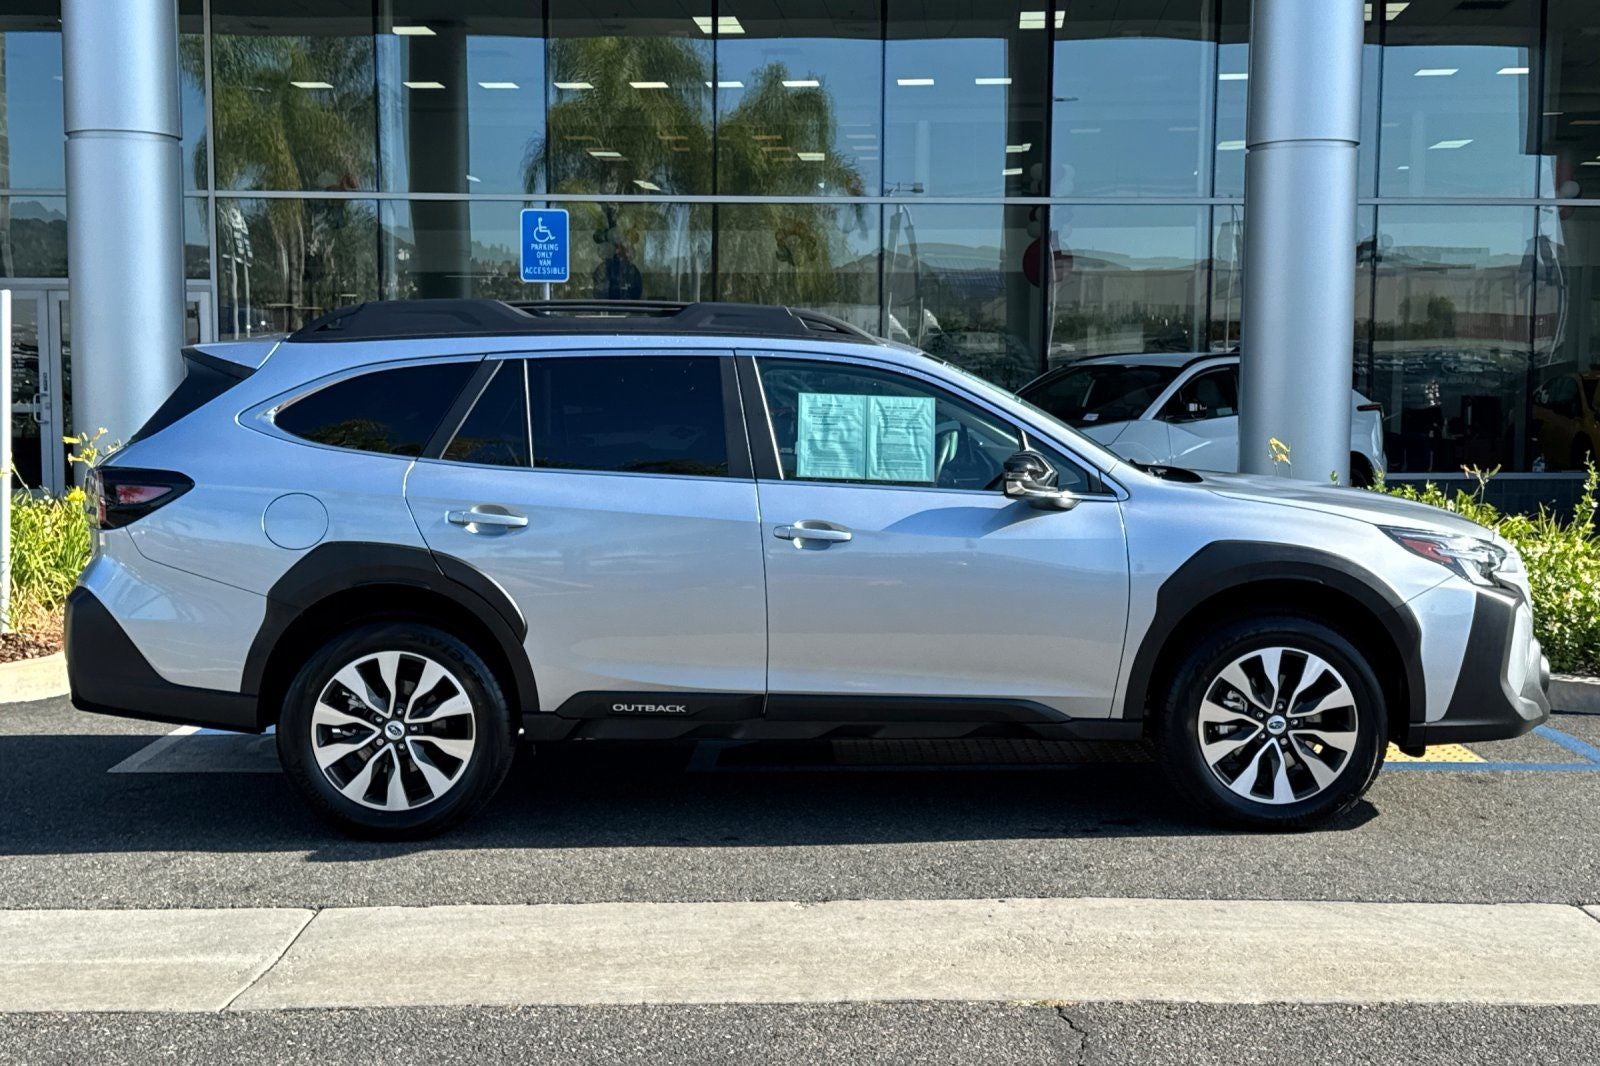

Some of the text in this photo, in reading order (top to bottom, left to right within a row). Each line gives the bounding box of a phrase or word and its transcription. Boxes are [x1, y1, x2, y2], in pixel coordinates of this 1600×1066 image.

[530, 243, 559, 251] PARKING
[525, 267, 566, 275] ACCESSIBLE
[612, 703, 687, 712] OUTBACK
